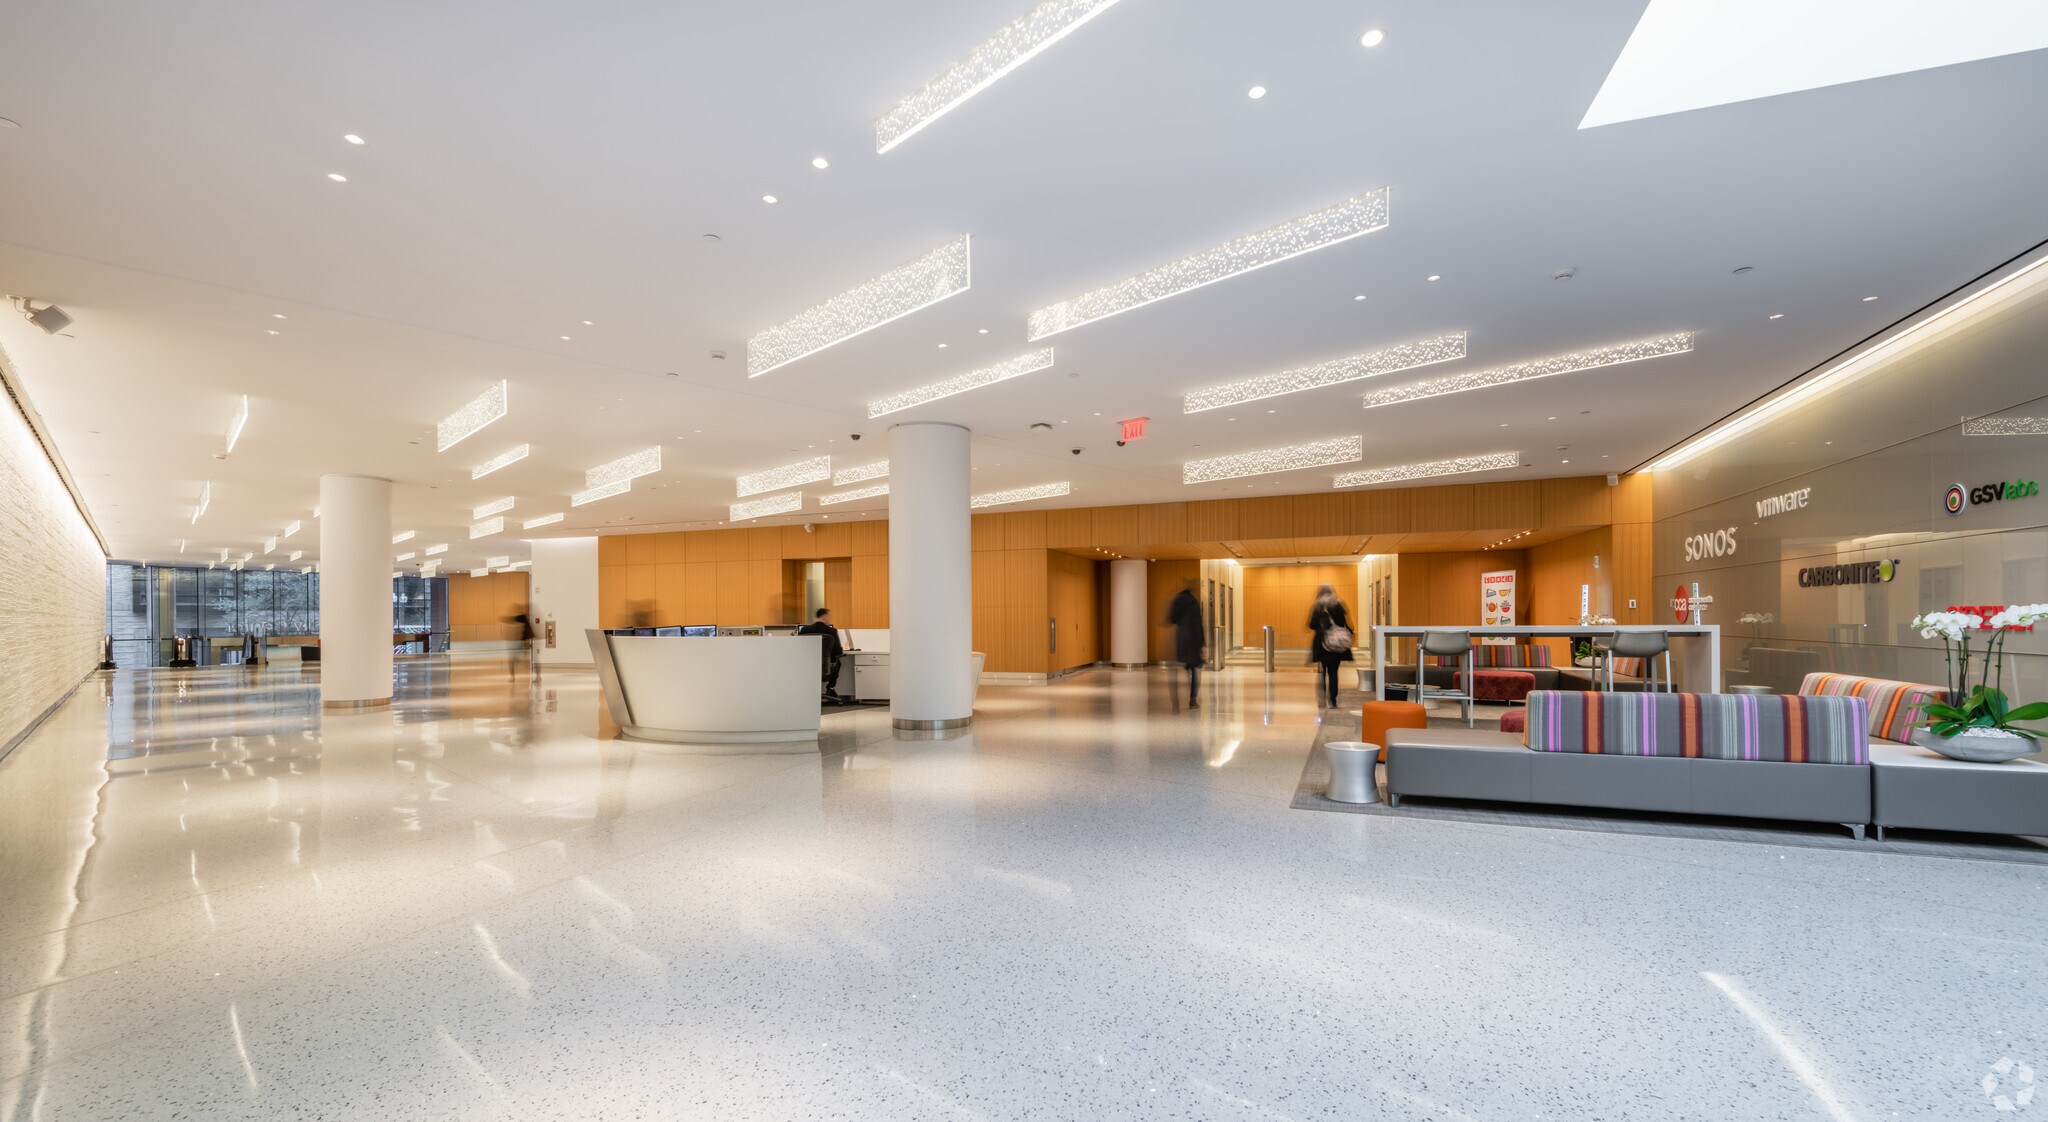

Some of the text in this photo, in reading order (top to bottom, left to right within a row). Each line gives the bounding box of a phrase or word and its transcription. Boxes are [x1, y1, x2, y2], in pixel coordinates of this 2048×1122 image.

[1124, 420, 1143, 439] EXIT
[1756, 488, 1810, 518] vmware
[1969, 479, 2039, 505] GSVlabs
[1685, 527, 1737, 562] SONOS
[1798, 561, 1880, 587] CARBONITE
